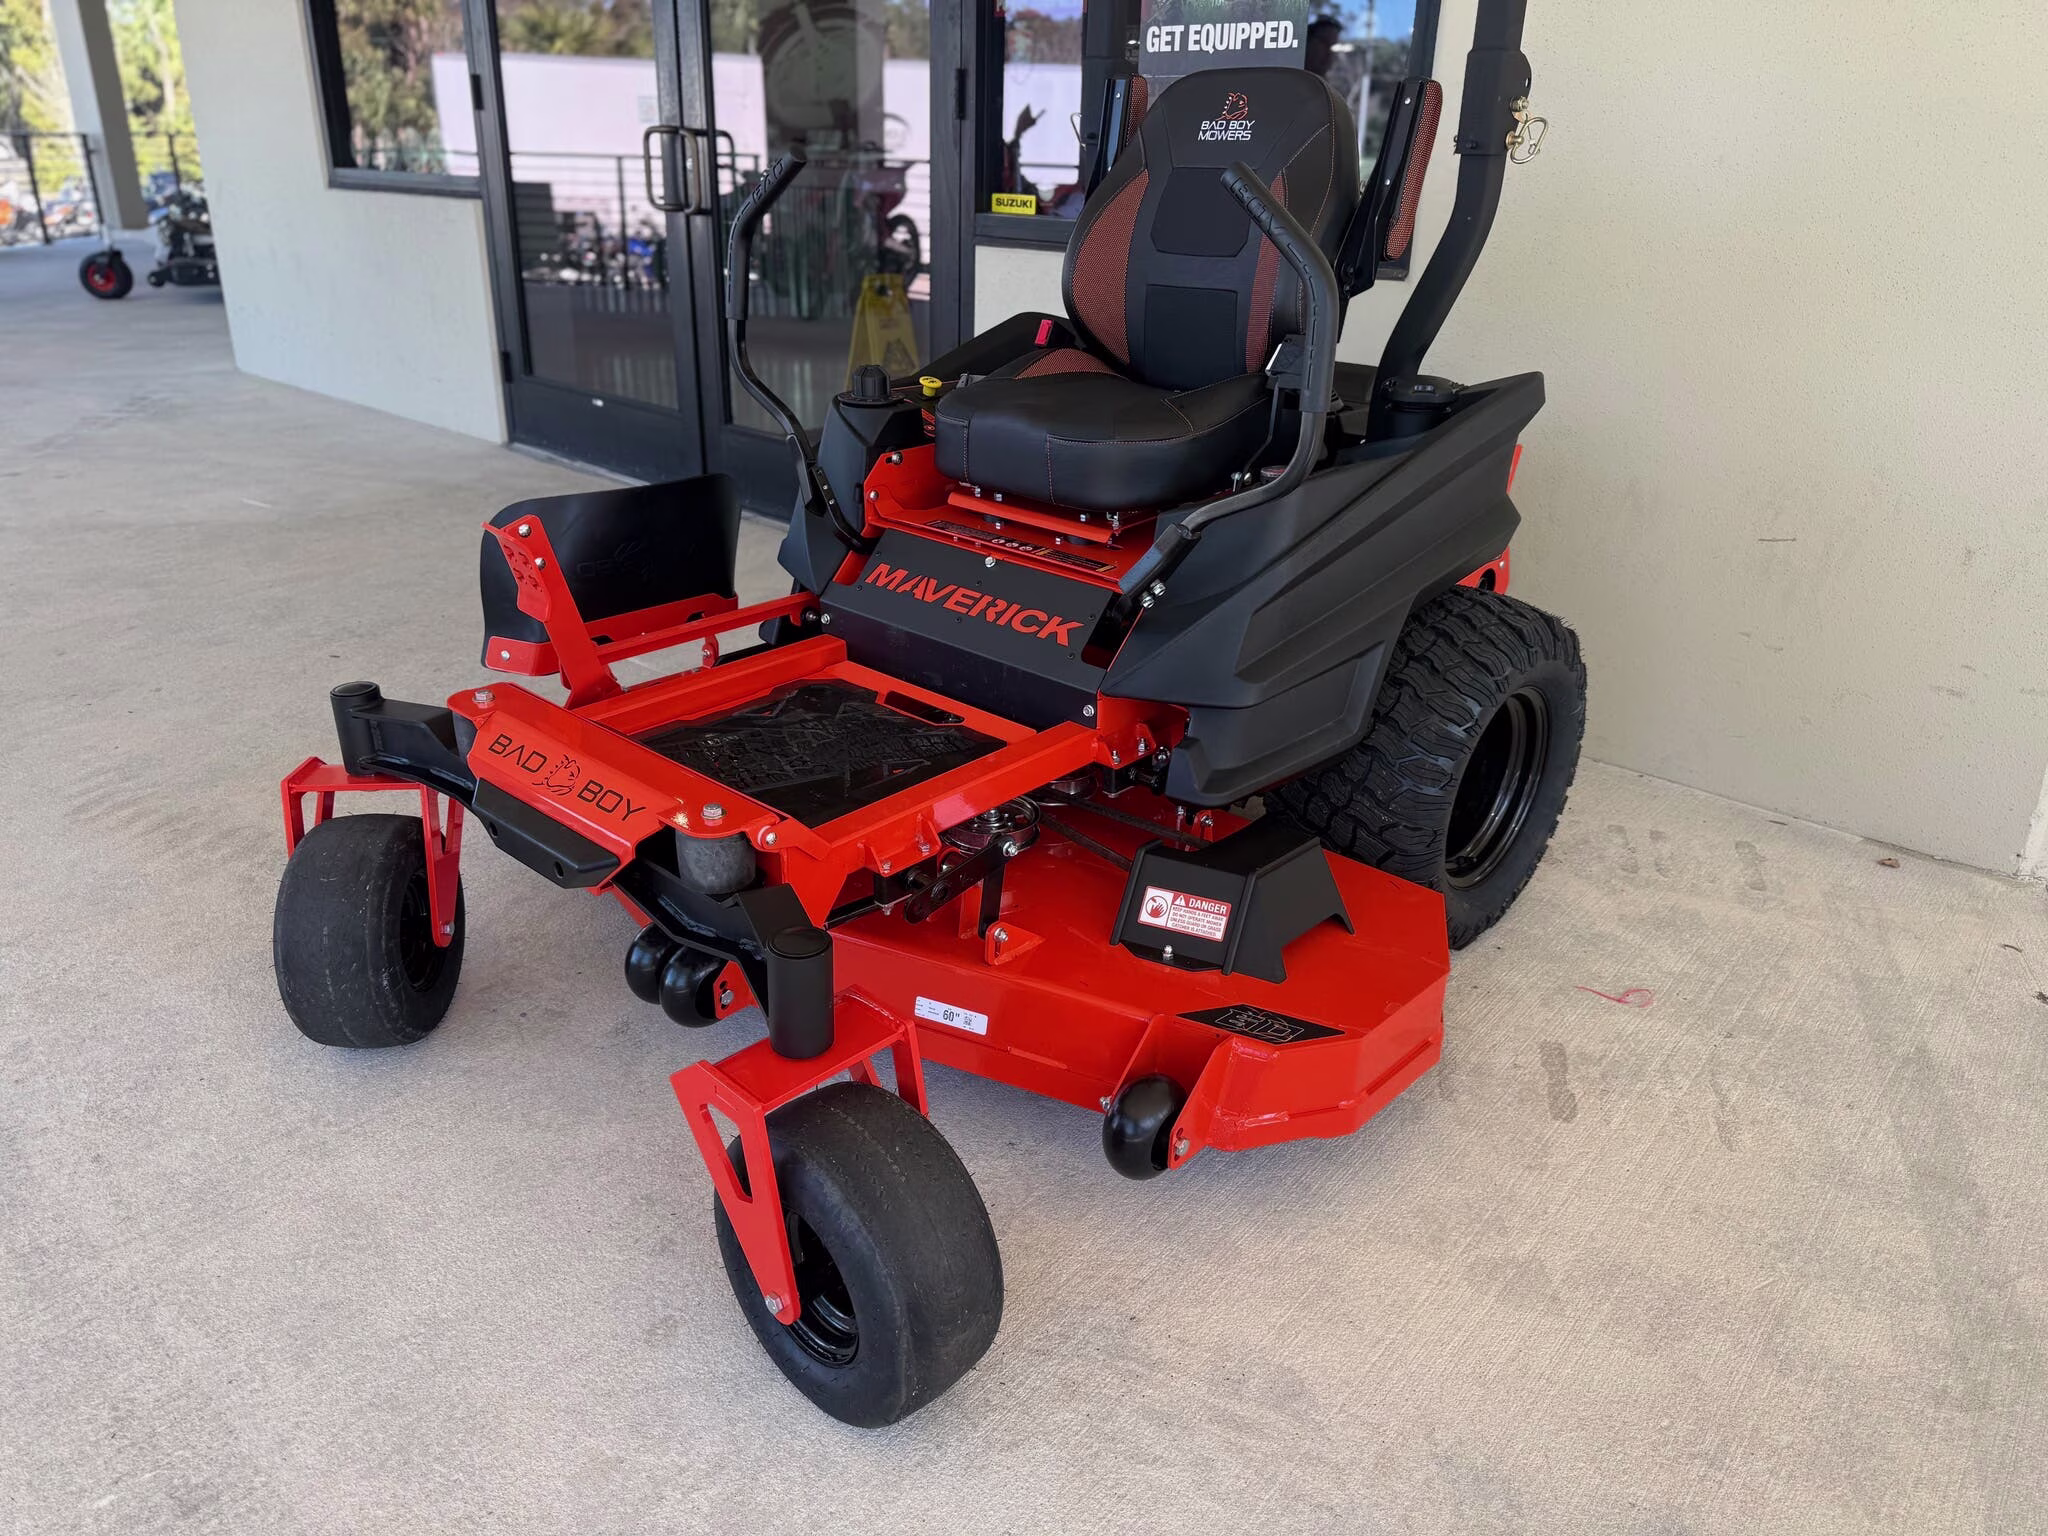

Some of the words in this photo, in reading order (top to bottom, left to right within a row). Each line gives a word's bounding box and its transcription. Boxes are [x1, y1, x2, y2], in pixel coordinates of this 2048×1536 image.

[1146, 25, 1185, 53] GET
[1188, 20, 1299, 54] EQUIPPED.
[1200, 120, 1226, 130] BAD
[1228, 119, 1255, 130] BOY
[1198, 130, 1252, 141] MOWERS
[995, 197, 1033, 209] SUZUKI
[864, 562, 1085, 647] MAVERICK
[488, 733, 548, 774] BAD
[576, 779, 647, 822] BOY
[1188, 898, 1227, 915] DANGER
